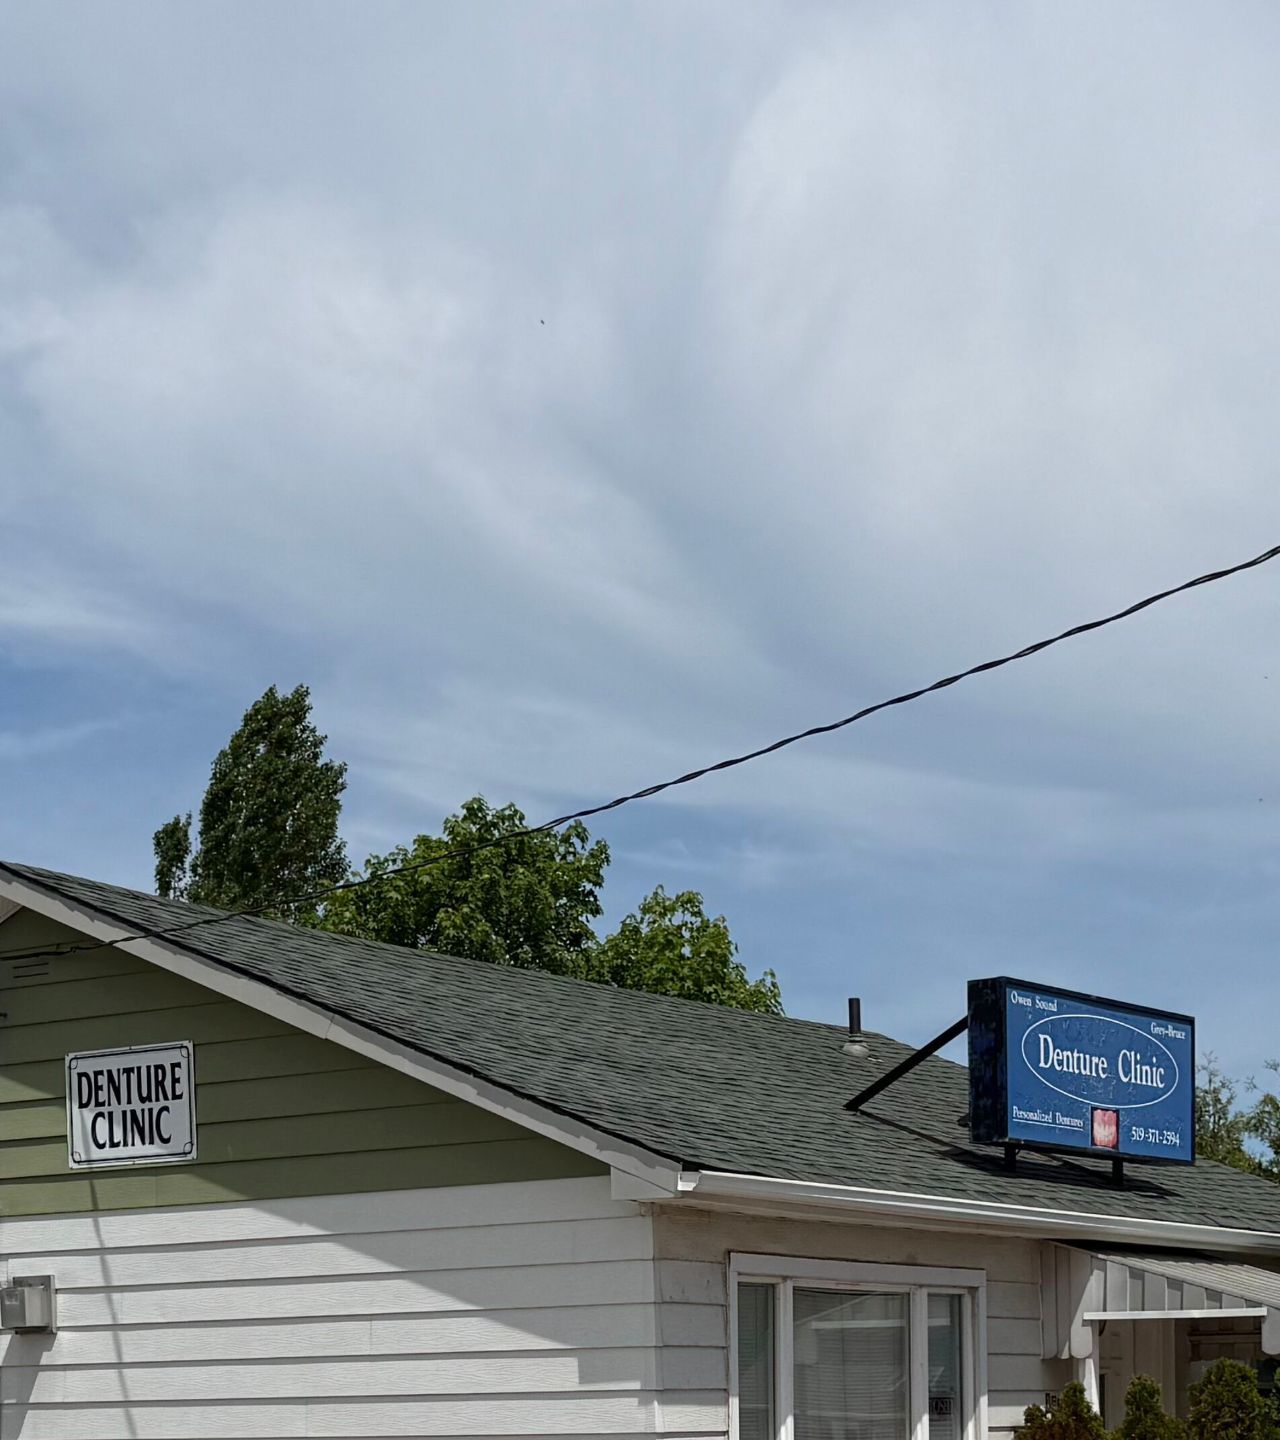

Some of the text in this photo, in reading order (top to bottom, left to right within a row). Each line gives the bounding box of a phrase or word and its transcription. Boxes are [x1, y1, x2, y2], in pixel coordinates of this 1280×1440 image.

[1011, 990, 1057, 1011] Owen Sound
[1150, 1021, 1186, 1040] Grey-Bruce
[1038, 1034, 1166, 1089] Denture Clinic
[76, 1061, 184, 1110] DENTURE
[90, 1105, 172, 1150] CLINIC
[1012, 1105, 1084, 1127] Personalized Dentures
